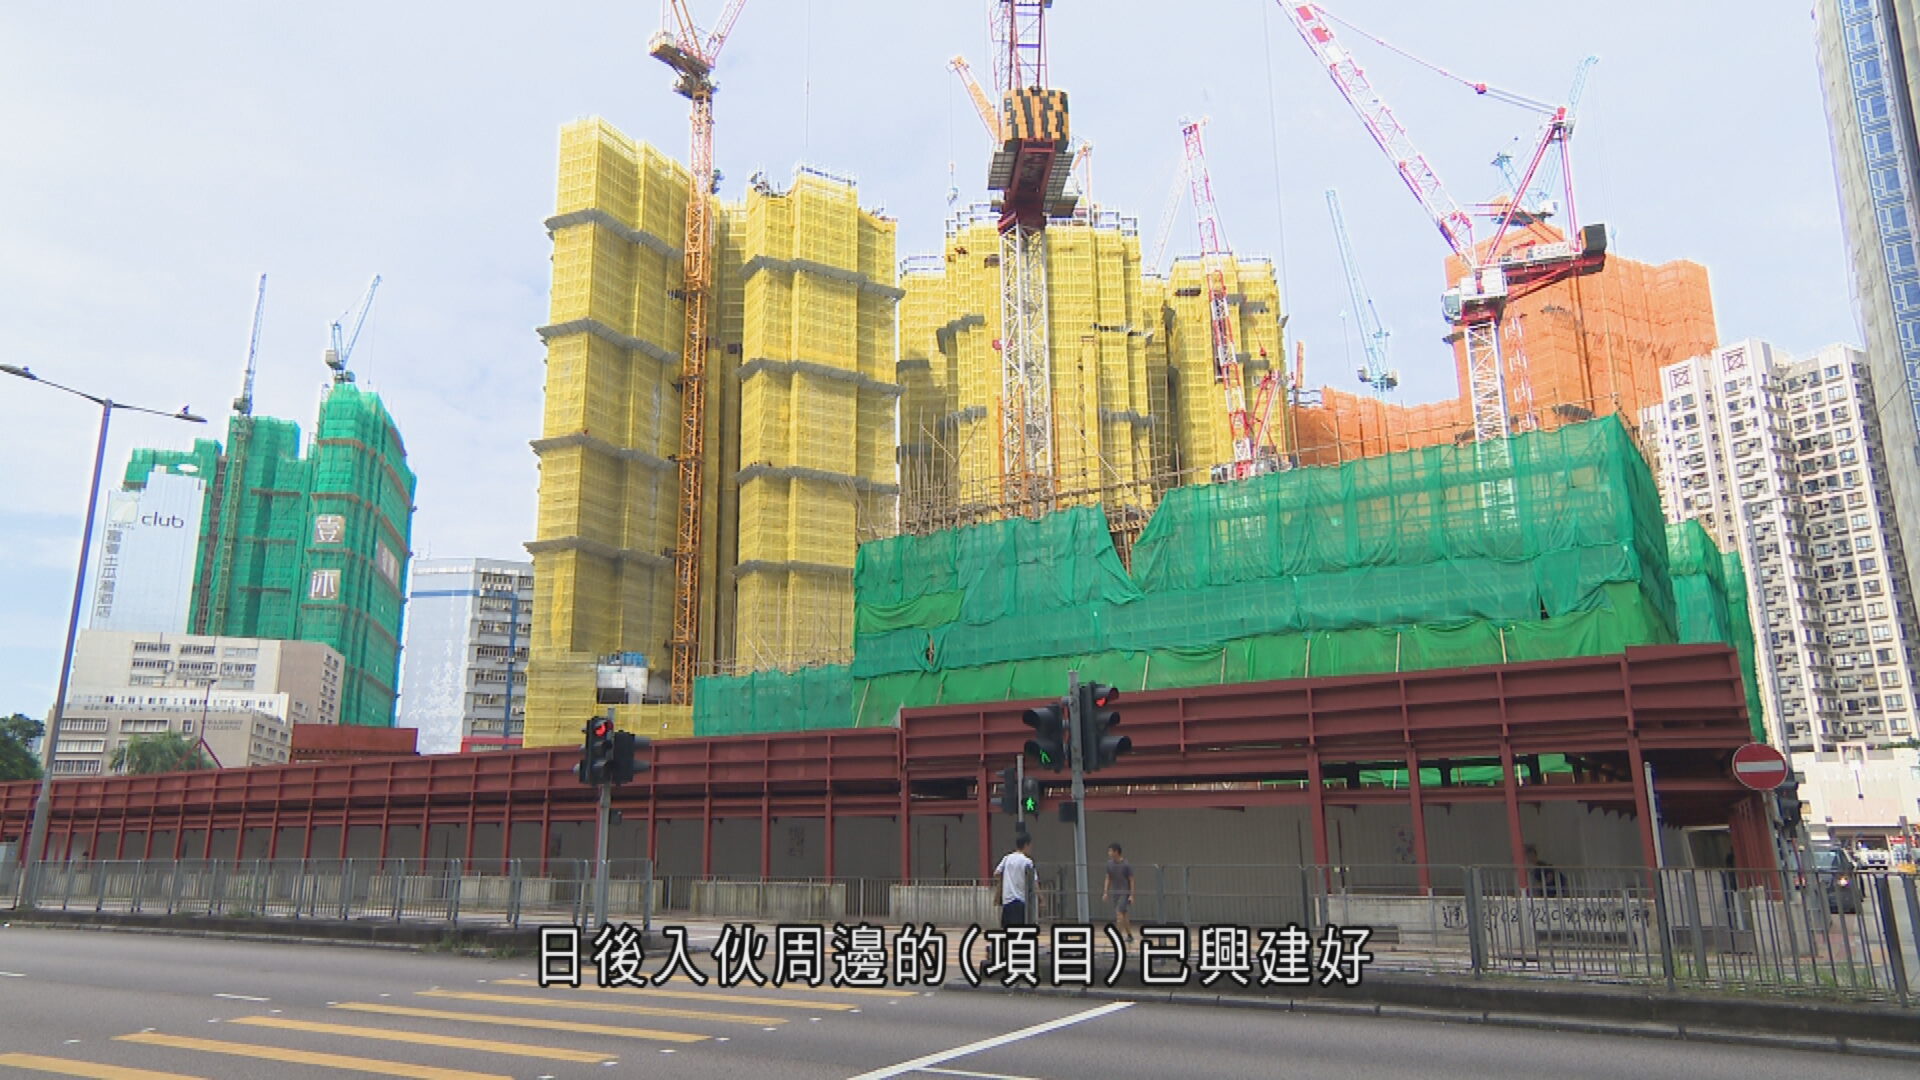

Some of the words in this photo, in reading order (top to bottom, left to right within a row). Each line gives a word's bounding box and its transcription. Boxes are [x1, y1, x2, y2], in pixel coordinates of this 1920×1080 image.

[141, 511, 184, 529] club
[95, 529, 123, 618] 土瓜酒店
